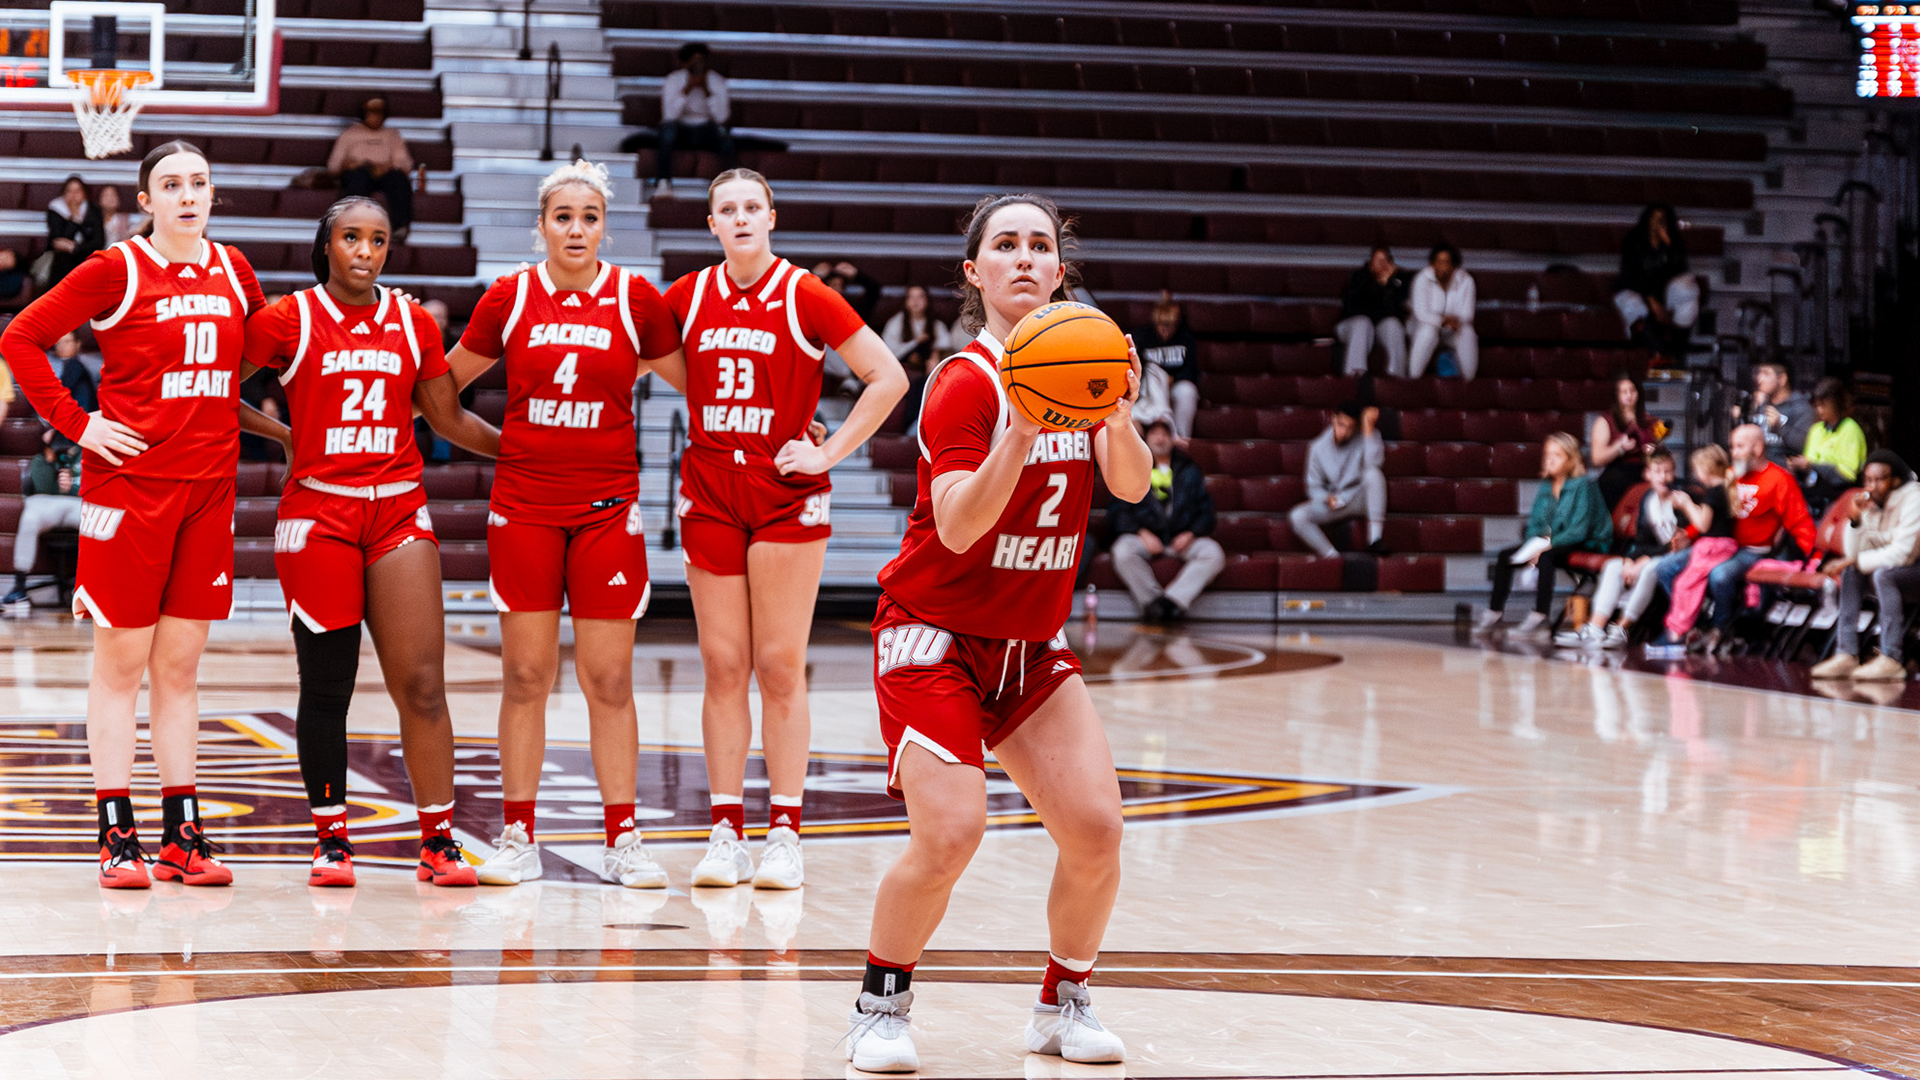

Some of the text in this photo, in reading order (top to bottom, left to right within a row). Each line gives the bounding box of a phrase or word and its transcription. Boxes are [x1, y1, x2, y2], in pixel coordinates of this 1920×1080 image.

[155, 294, 231, 322] SACRED
[183, 322, 217, 365] 10
[527, 323, 612, 350] SACRED
[698, 327, 777, 355] SACRED
[321, 350, 402, 376] SACRED
[553, 352, 579, 394] 4
[715, 357, 755, 400] 33
[161, 370, 233, 399] HEART
[341, 378, 387, 421] 24
[528, 397, 604, 428] HEART
[702, 405, 775, 436] HEART
[324, 426, 398, 455] HEART
[1024, 430, 1091, 466] ACRED
[1036, 473, 1068, 528] 2
[275, 518, 317, 553] HU
[878, 624, 954, 677] SHU
